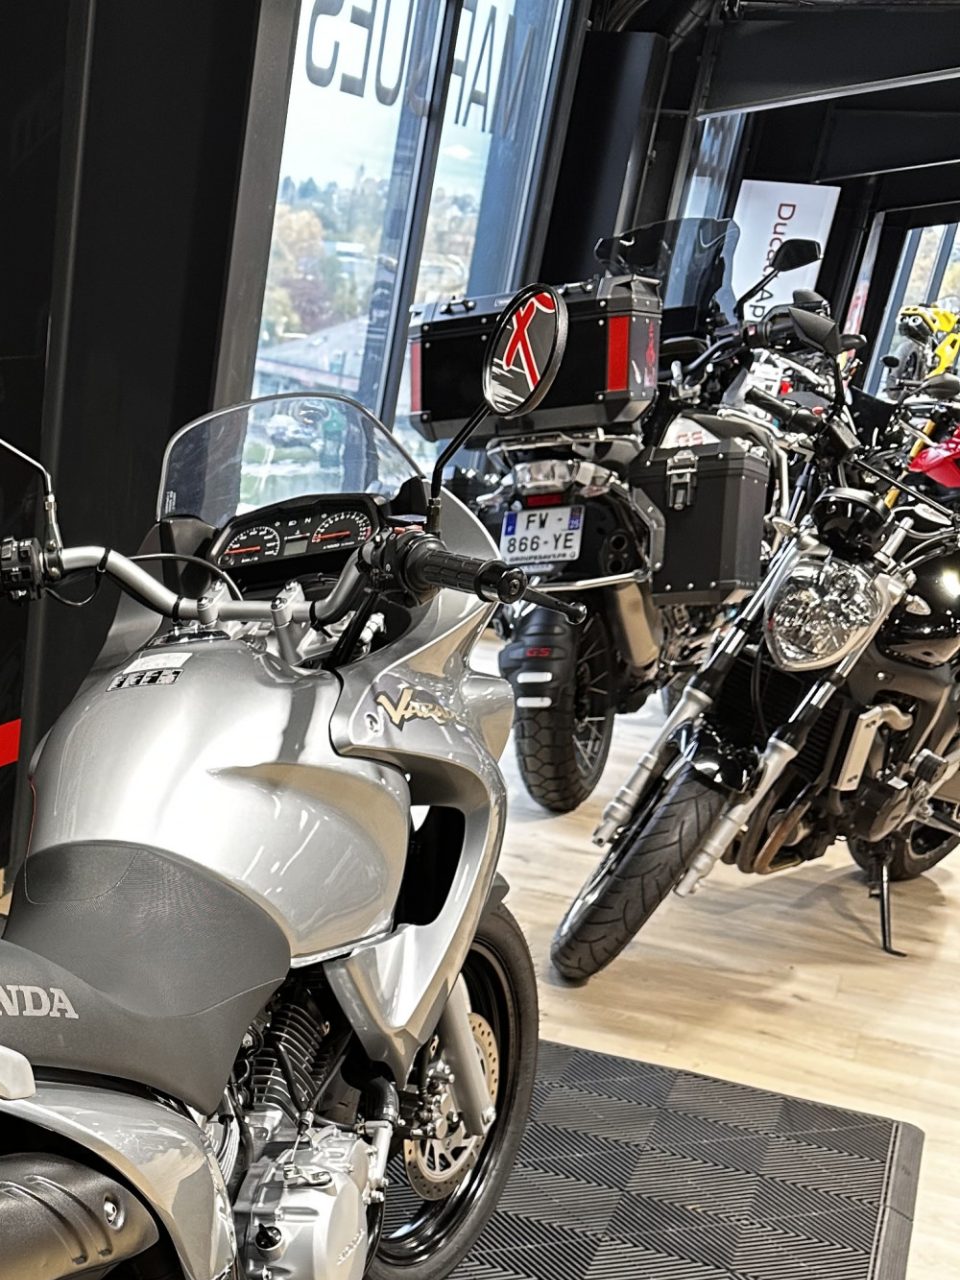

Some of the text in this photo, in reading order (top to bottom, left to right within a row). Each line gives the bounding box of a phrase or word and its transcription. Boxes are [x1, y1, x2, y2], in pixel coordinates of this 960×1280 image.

[761, 202, 797, 280] Ducat
[507, 533, 574, 554] 866-YE
[526, 647, 552, 657] GS
